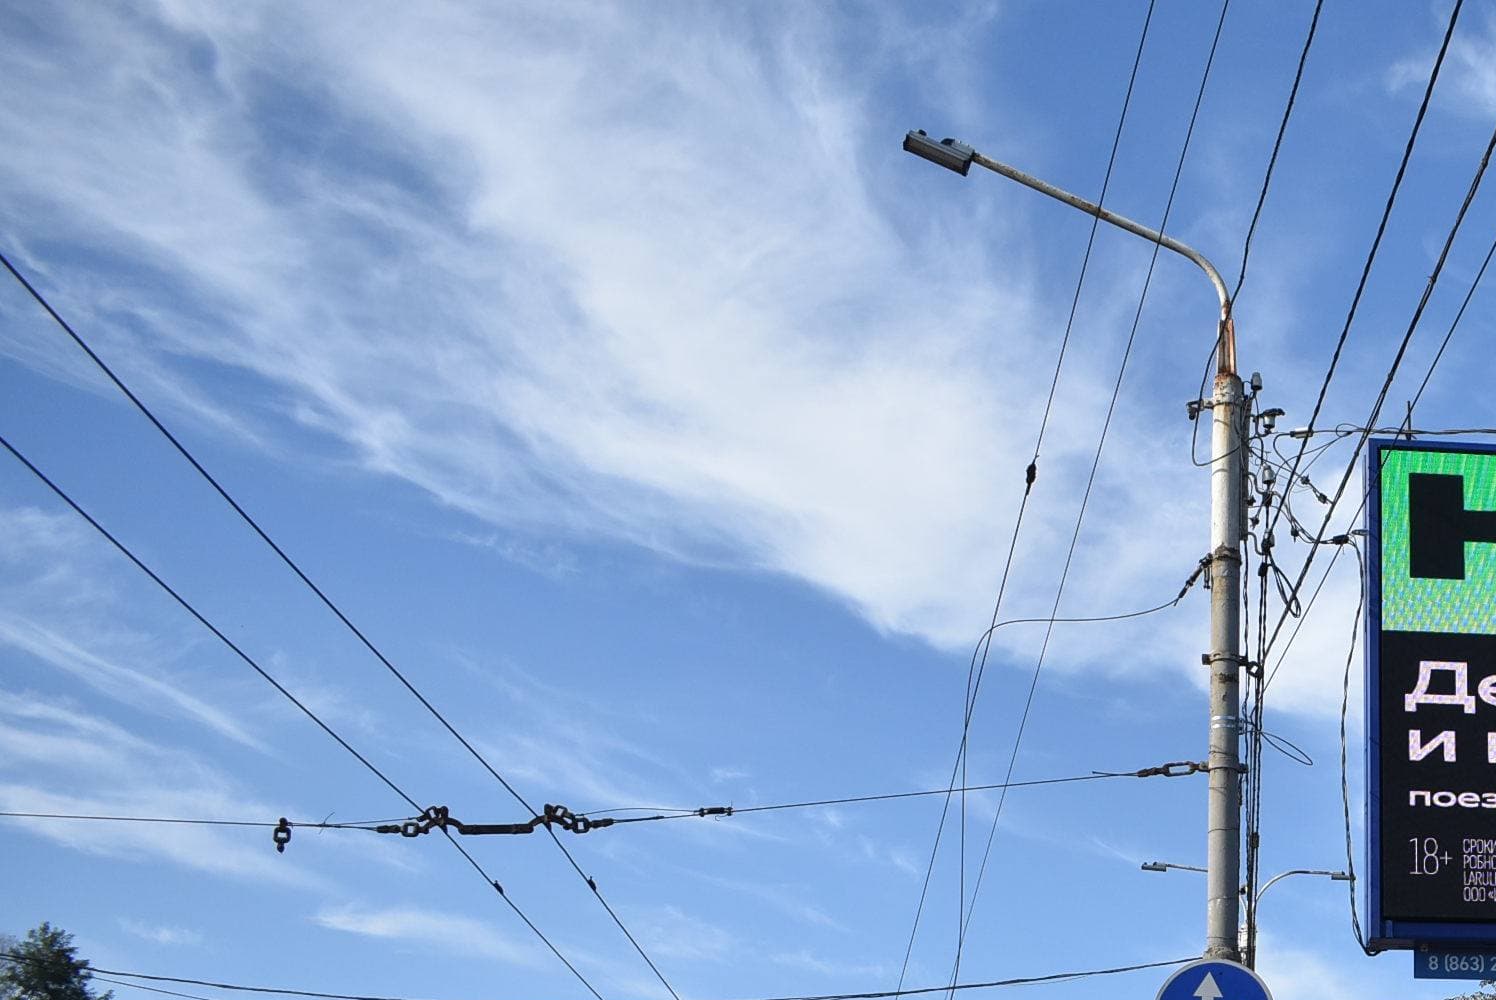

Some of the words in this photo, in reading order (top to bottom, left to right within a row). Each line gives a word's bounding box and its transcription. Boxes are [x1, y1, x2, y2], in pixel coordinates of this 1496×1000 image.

[1408, 729, 1456, 762] и
[1409, 837, 1454, 875] 18+
[1463, 887, 1486, 902] ООО
[1428, 956, 1438, 971] 8
[1444, 954, 1484, 973] (863)
